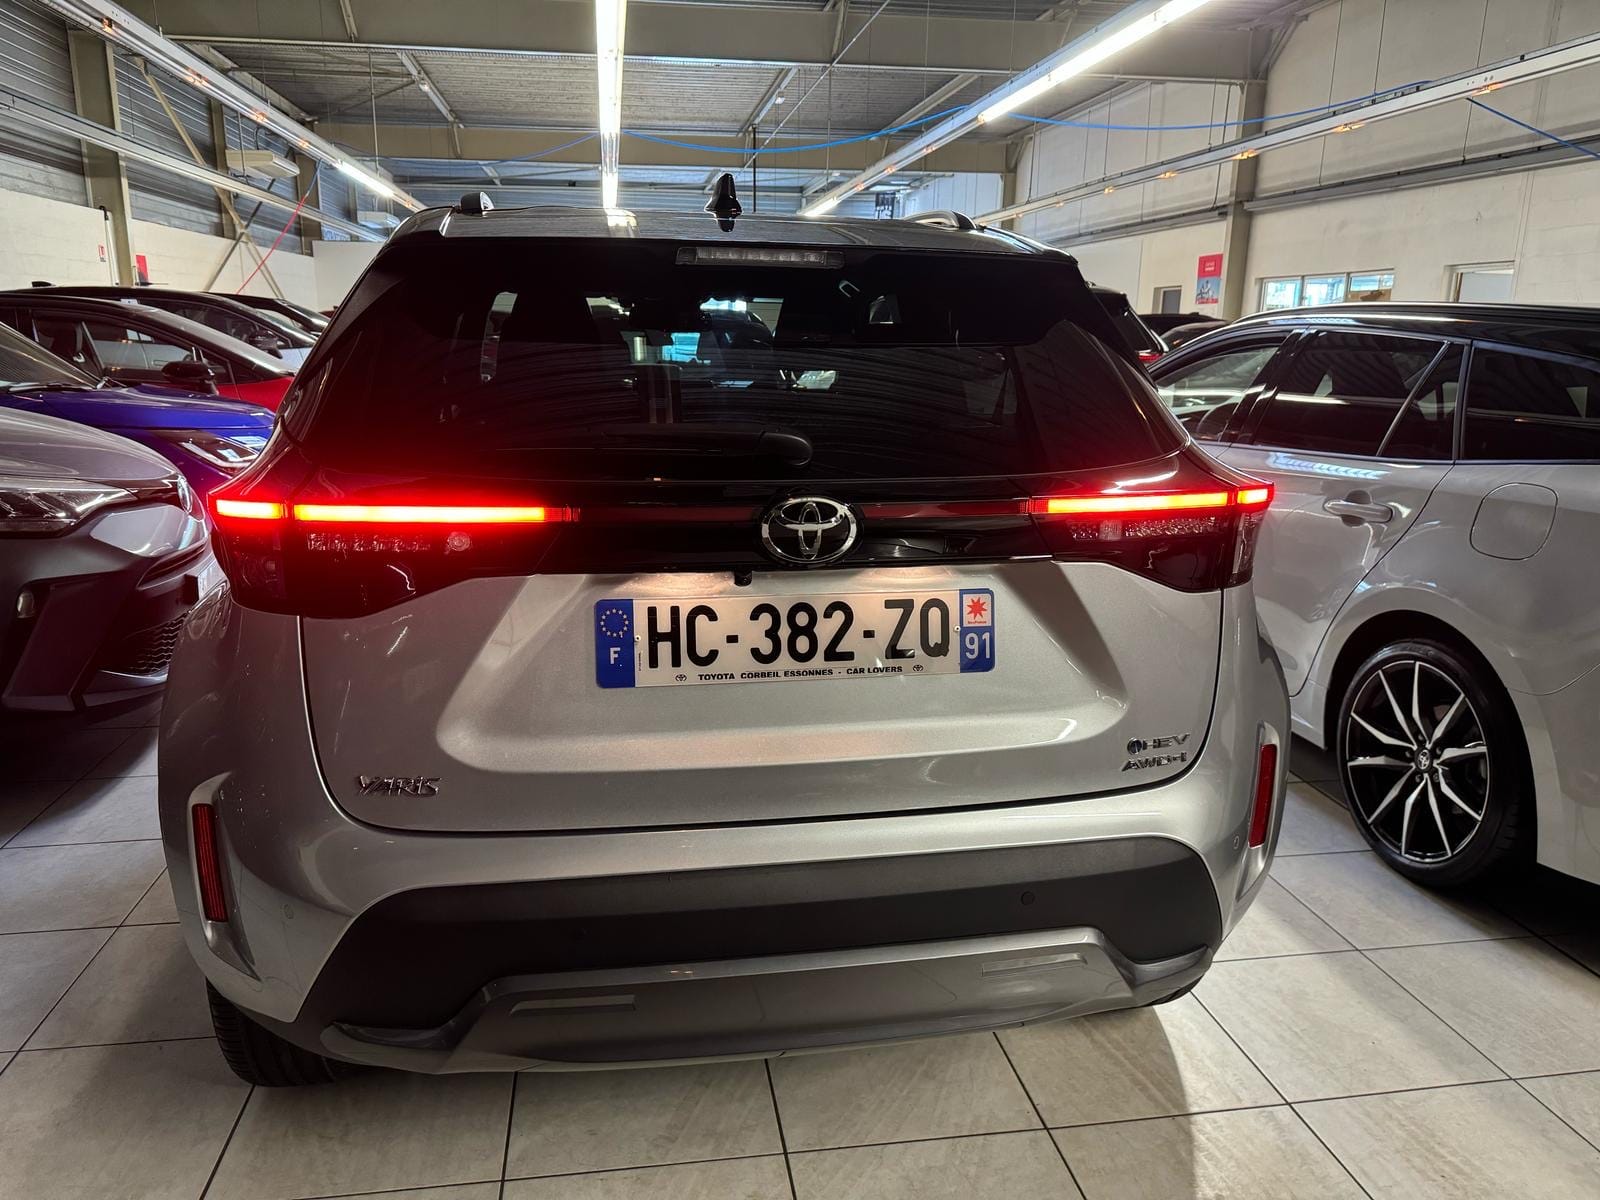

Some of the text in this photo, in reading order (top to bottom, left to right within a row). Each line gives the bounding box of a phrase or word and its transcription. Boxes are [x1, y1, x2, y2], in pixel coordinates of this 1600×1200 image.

[647, 597, 950, 669] HC-382-ZQ
[609, 646, 621, 665] F
[964, 632, 991, 660] 91
[697, 672, 736, 681] TOYOTA
[740, 671, 781, 680] CORBEIL
[783, 668, 834, 678] ESSONNES
[846, 667, 866, 675] CAR
[867, 665, 903, 674] LOVERS
[1142, 732, 1191, 751] HEV
